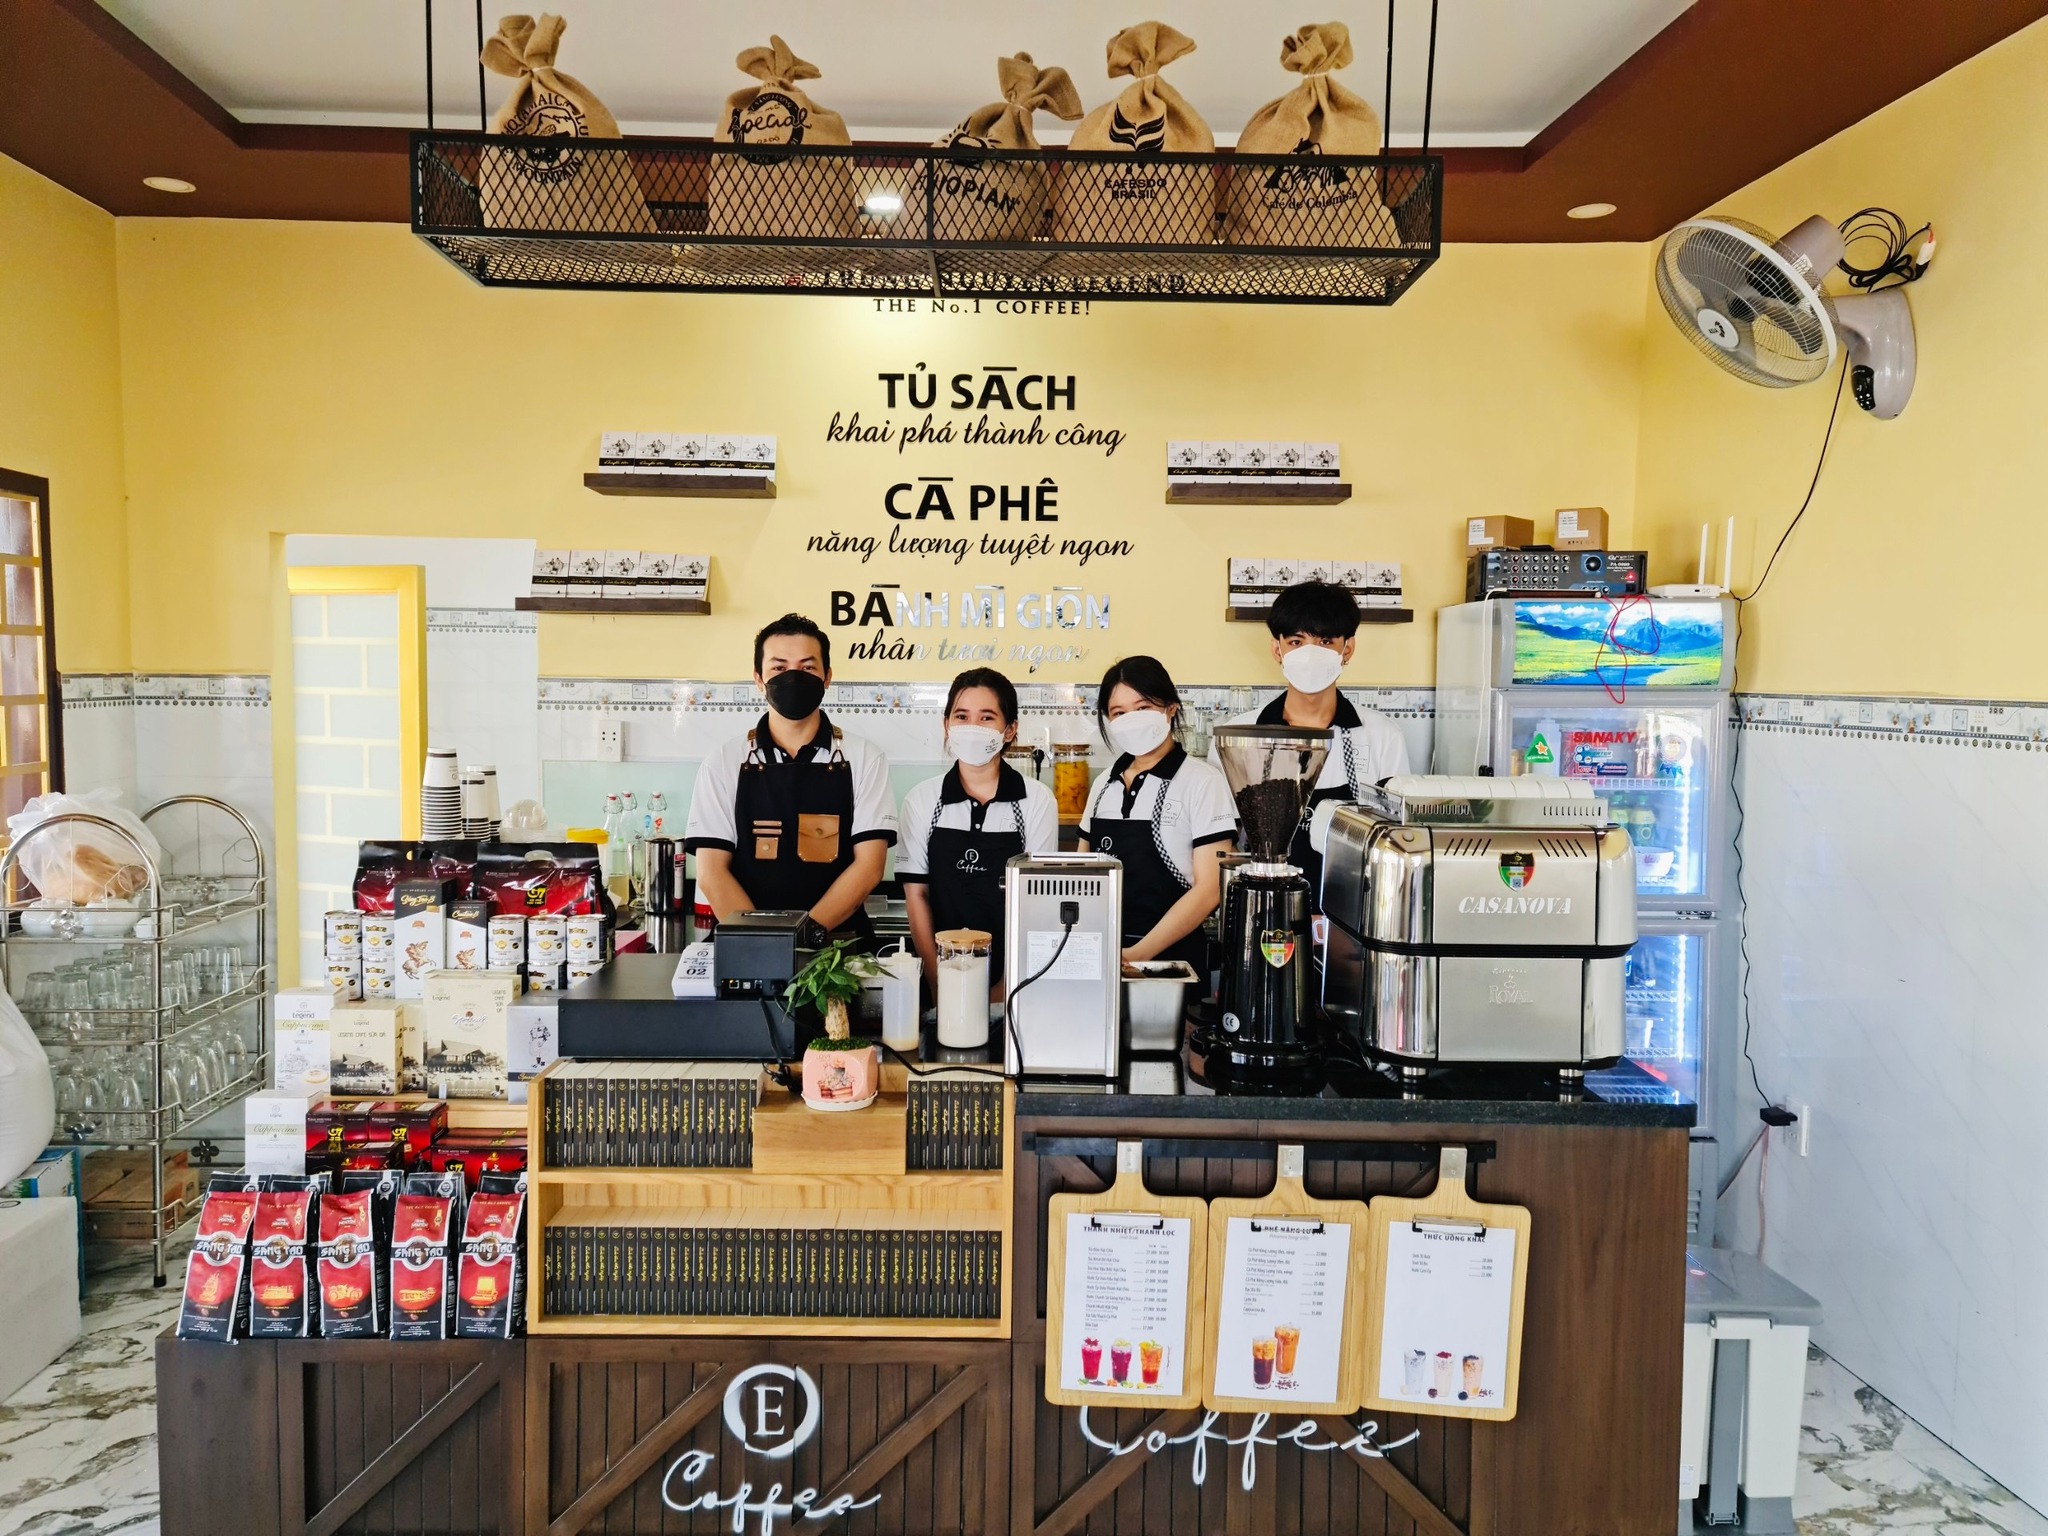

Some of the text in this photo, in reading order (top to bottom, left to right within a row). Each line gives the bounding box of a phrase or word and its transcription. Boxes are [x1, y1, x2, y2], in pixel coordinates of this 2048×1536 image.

[873, 298, 1091, 316] THE No.1 COFFEE!
[878, 361, 937, 409] TỦ
[826, 411, 1127, 457] khai phá thành công
[969, 477, 1059, 522] PHÊ
[806, 524, 1134, 567] năng lượng tuyệt ngon
[848, 628, 932, 661] nhân
[1007, 645, 1089, 674] ngon
[1573, 732, 1637, 743] SANAKY
[1458, 896, 1571, 914] CASANOVA
[686, 968, 707, 976] 02
[292, 1012, 314, 1020] Legend
[253, 1124, 298, 1135] Cappuccino
[753, 1386, 785, 1435] E
[662, 1449, 882, 1536] Coffee
